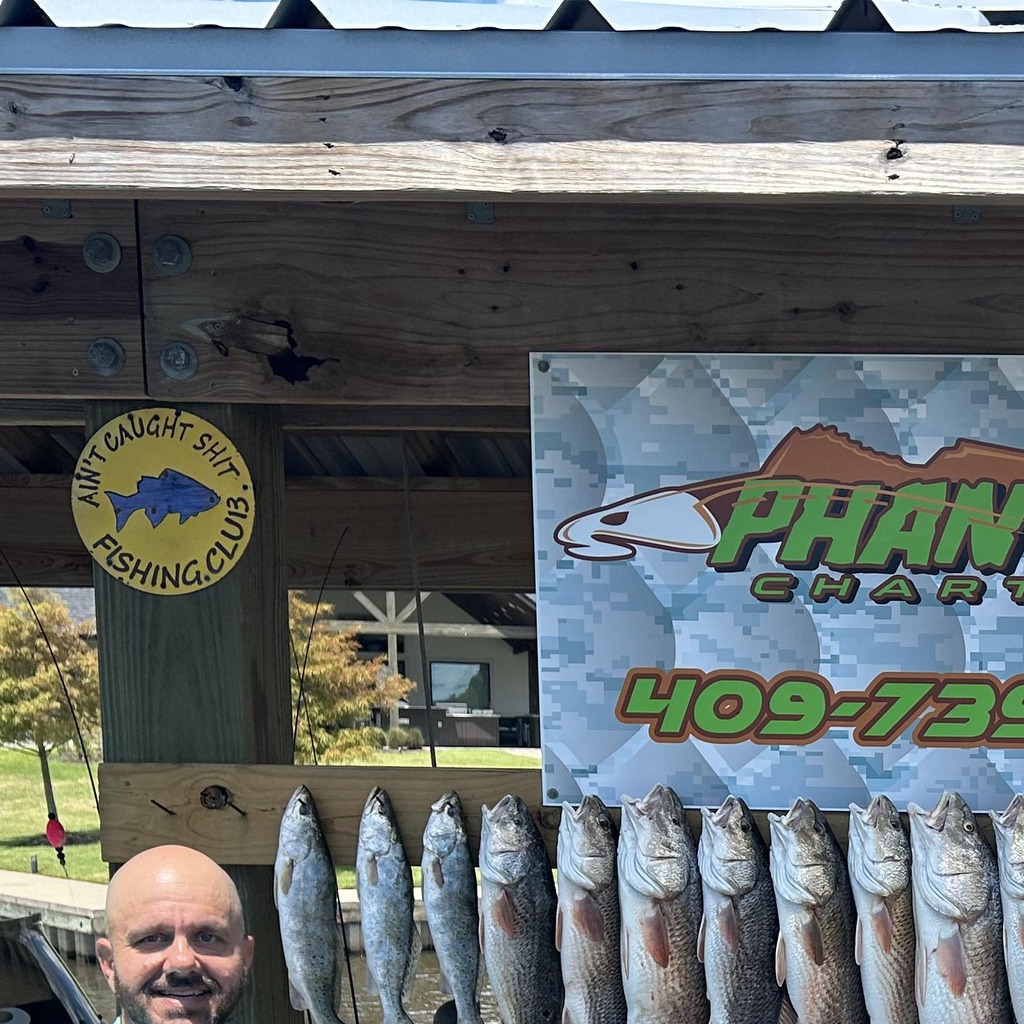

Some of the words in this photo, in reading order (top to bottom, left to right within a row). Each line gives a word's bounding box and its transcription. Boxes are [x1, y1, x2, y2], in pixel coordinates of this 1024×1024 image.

[75, 445, 106, 508] AIN'T
[104, 412, 194, 452] CAUGHT
[193, 433, 241, 477] SHIT
